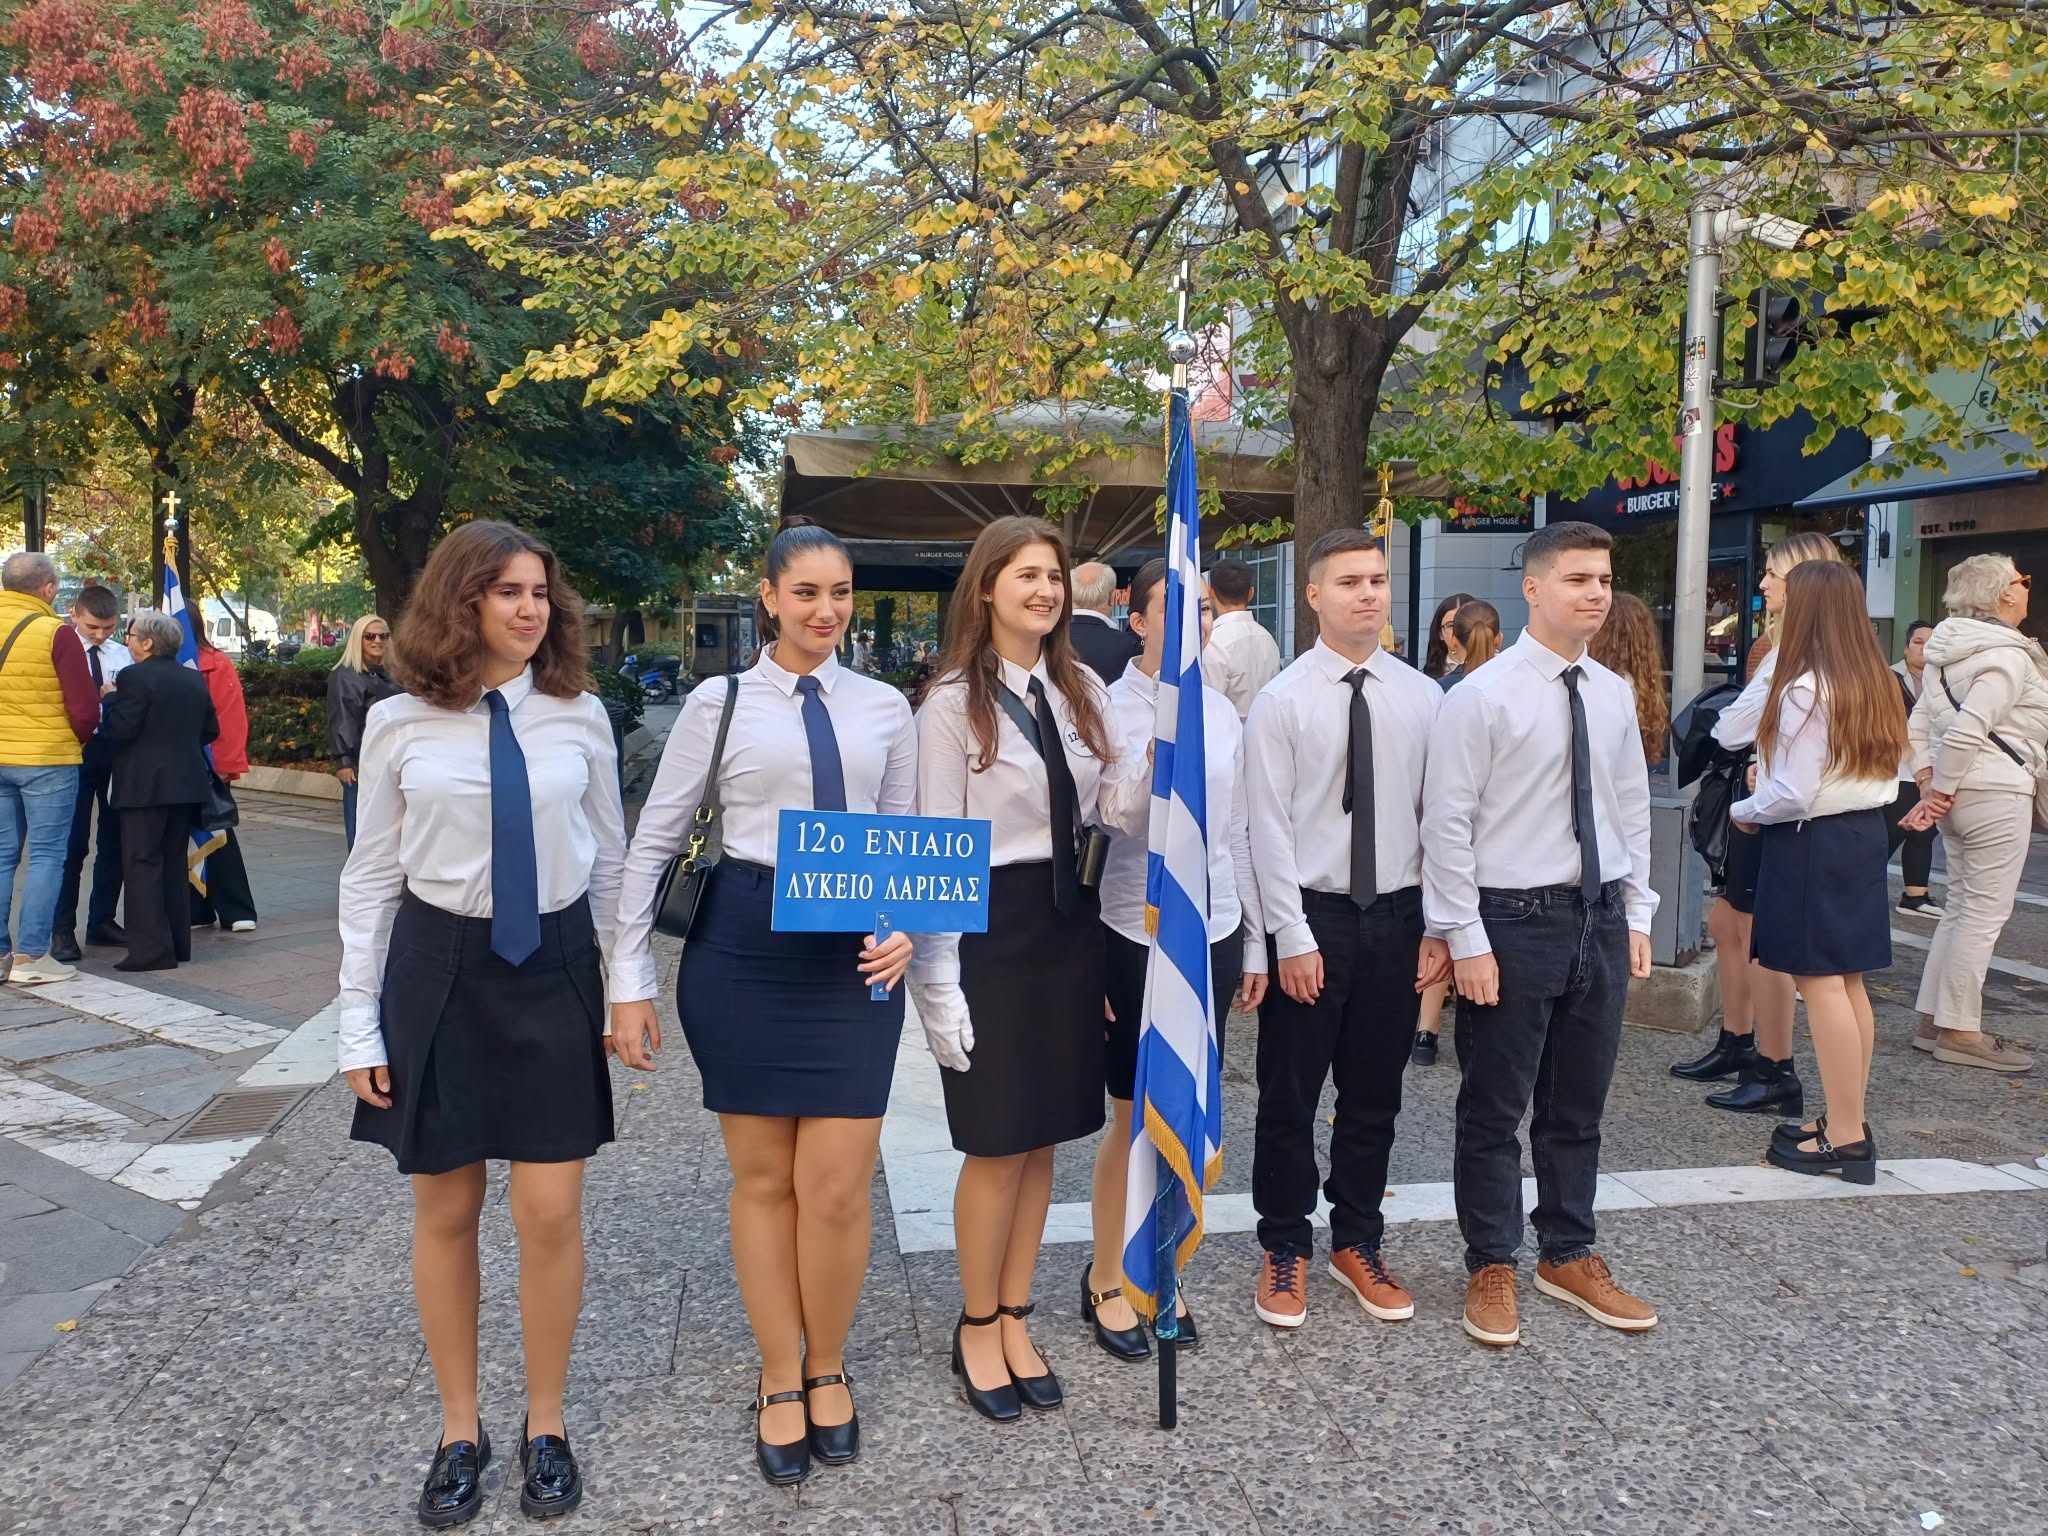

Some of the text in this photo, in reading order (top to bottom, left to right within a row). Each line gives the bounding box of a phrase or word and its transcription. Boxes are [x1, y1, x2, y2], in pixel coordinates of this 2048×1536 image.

[1627, 491, 1671, 513] BURGER
[1493, 517, 1519, 525] HOUSE
[864, 829, 974, 858] ΕΝΙΑΙΟ
[785, 872, 980, 902] ΛΥΚΕΙΟ ΛΑΡΙΣΑΣ
